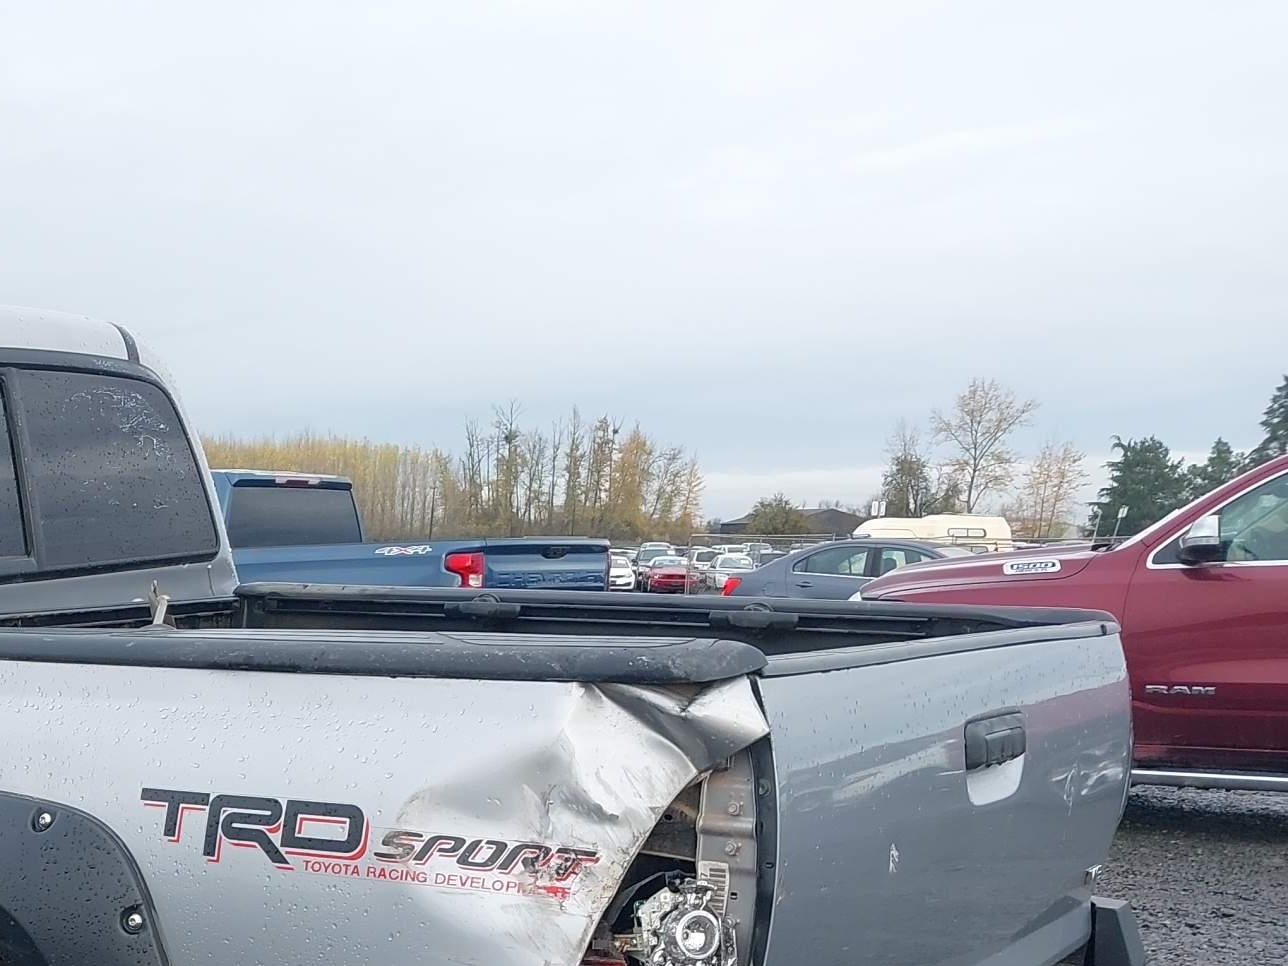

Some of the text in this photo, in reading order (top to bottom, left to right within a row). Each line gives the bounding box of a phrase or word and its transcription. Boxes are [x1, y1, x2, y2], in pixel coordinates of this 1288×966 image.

[1145, 685, 1216, 695] RAM
[140, 787, 600, 882] TRD SPORT
[303, 860, 361, 877] TOYOTA
[366, 866, 428, 883] RACING
